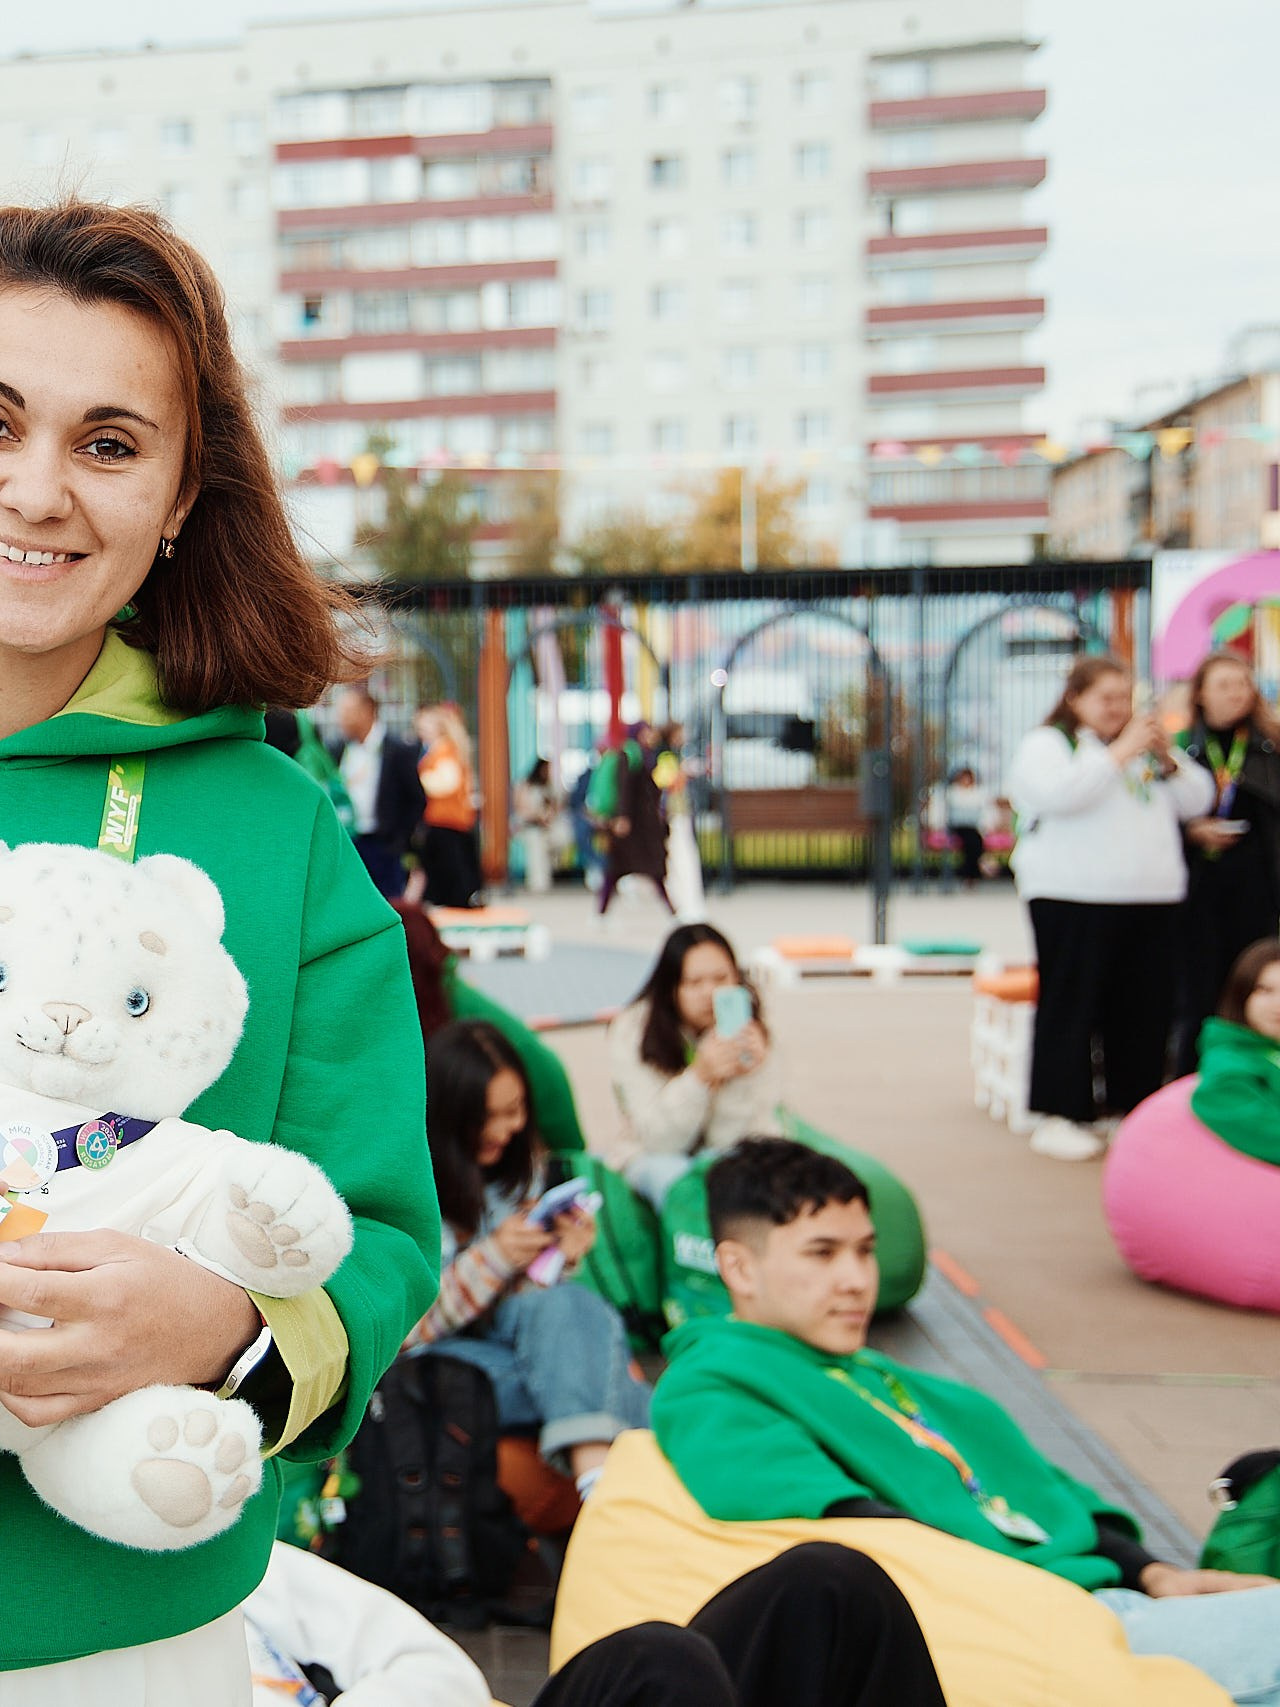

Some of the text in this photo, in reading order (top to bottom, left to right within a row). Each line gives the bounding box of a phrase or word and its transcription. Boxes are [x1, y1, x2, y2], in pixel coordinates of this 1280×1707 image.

[105, 786, 130, 843] WYF
[100, 1124, 114, 1143] 2024
[80, 1151, 112, 1169] ROSATOM
